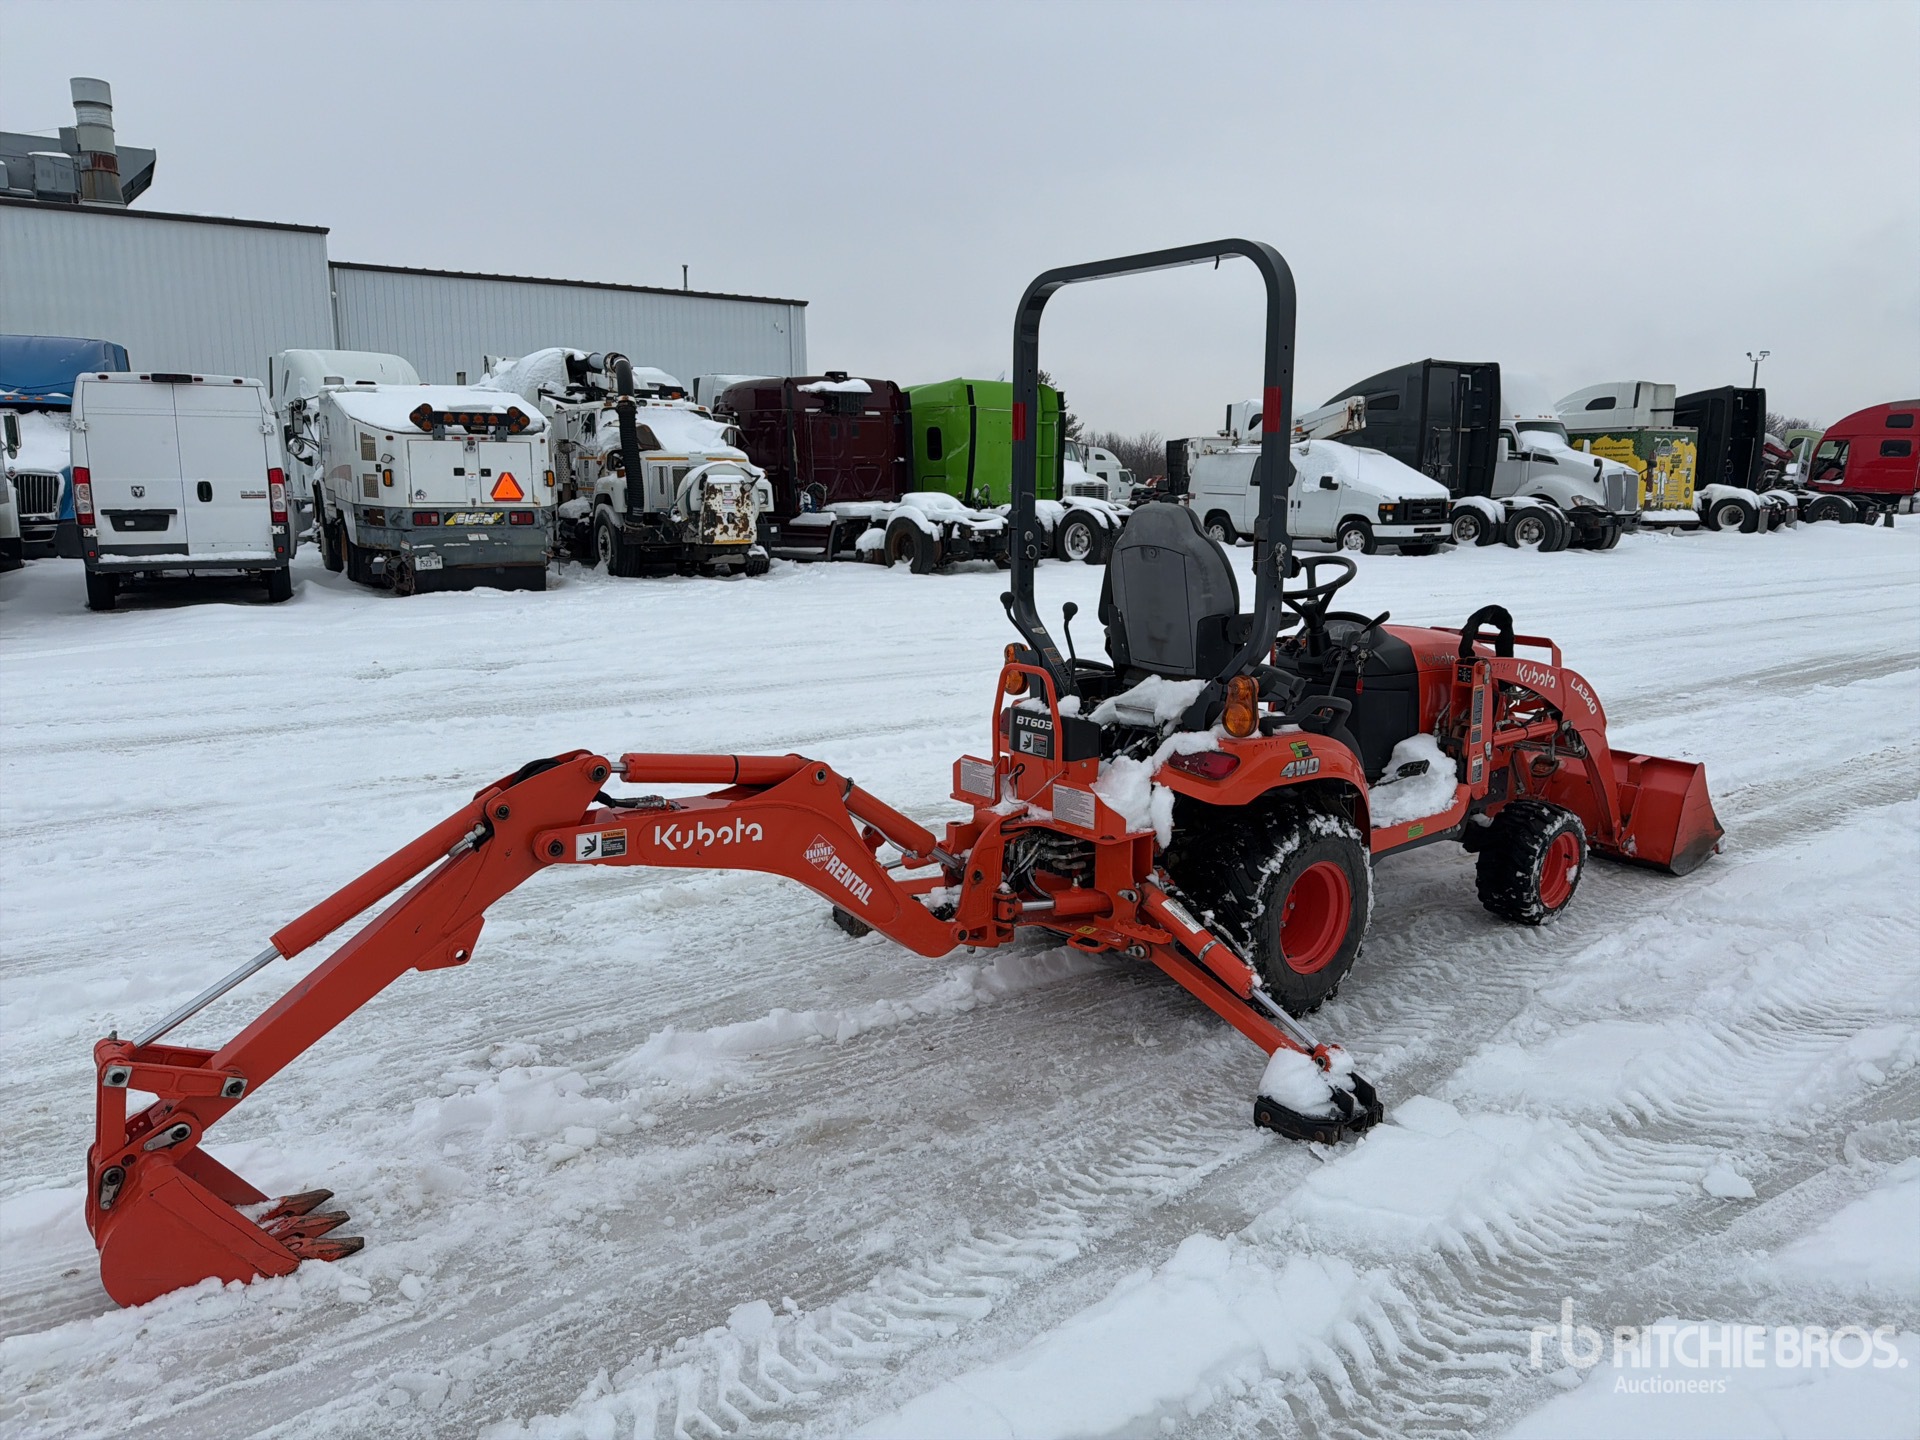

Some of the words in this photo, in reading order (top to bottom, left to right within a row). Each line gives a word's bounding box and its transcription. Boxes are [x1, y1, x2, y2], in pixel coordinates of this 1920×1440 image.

[1516, 662, 1556, 689] Kubota
[1570, 677, 1598, 715] LA340
[1016, 715, 1053, 730] BT603
[1280, 757, 1320, 778] 4WD
[654, 817, 763, 851] Kubota
[806, 846, 833, 859] HOME
[825, 855, 873, 906] RENTAL
